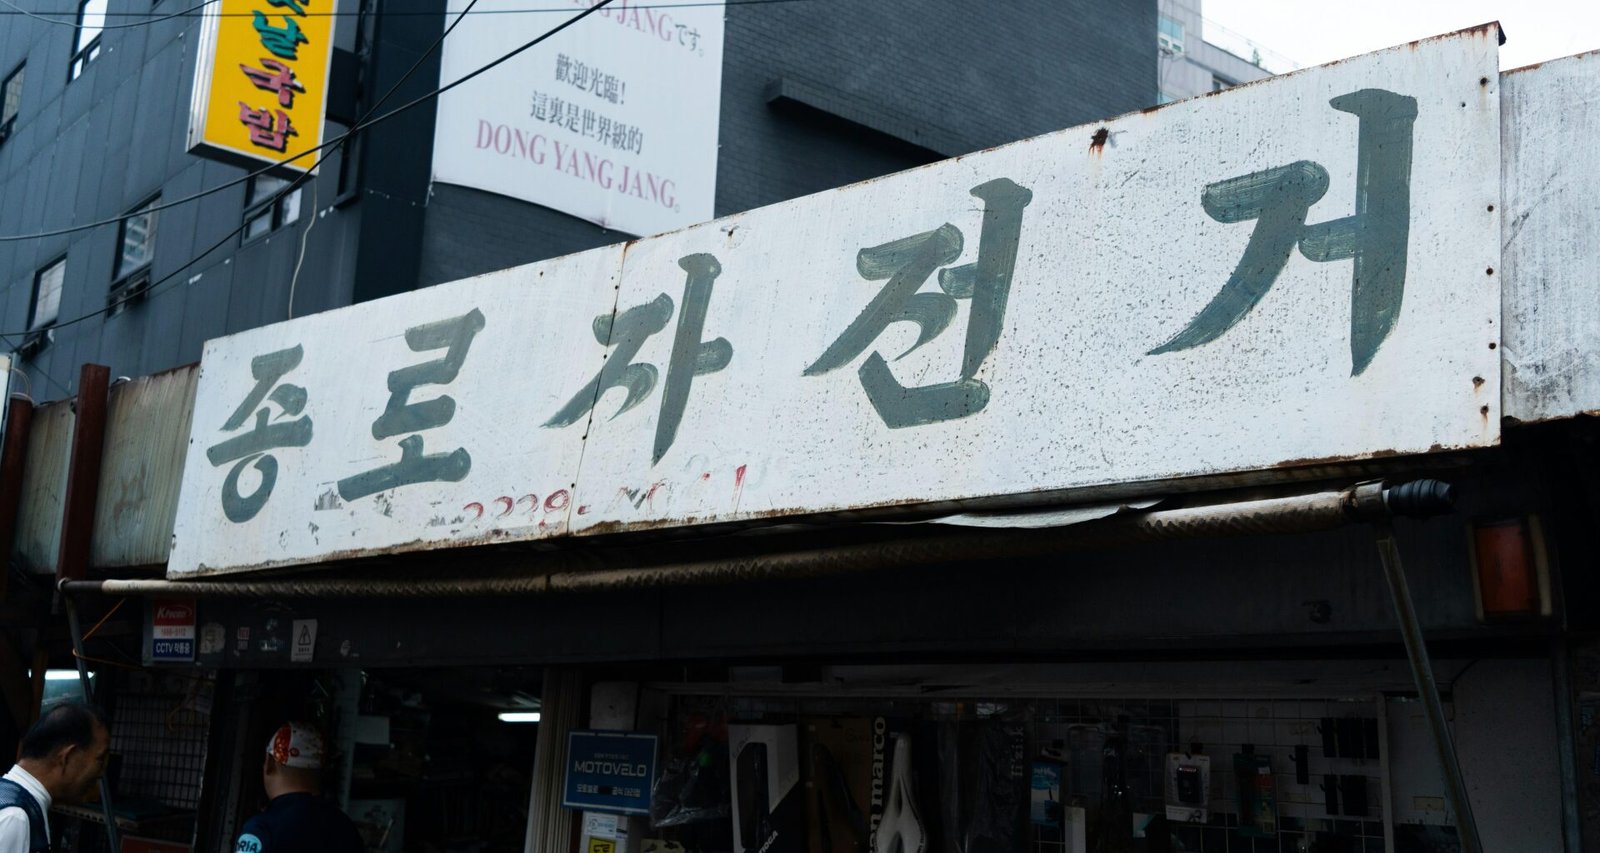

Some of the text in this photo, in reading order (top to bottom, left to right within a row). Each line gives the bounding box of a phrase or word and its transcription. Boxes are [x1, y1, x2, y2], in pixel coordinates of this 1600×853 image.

[475, 119, 547, 166] DONG
[552, 140, 614, 190] YANG
[155, 642, 174, 654] CCTV
[574, 760, 647, 777] MOTOVELO
[871, 716, 886, 807] marco
